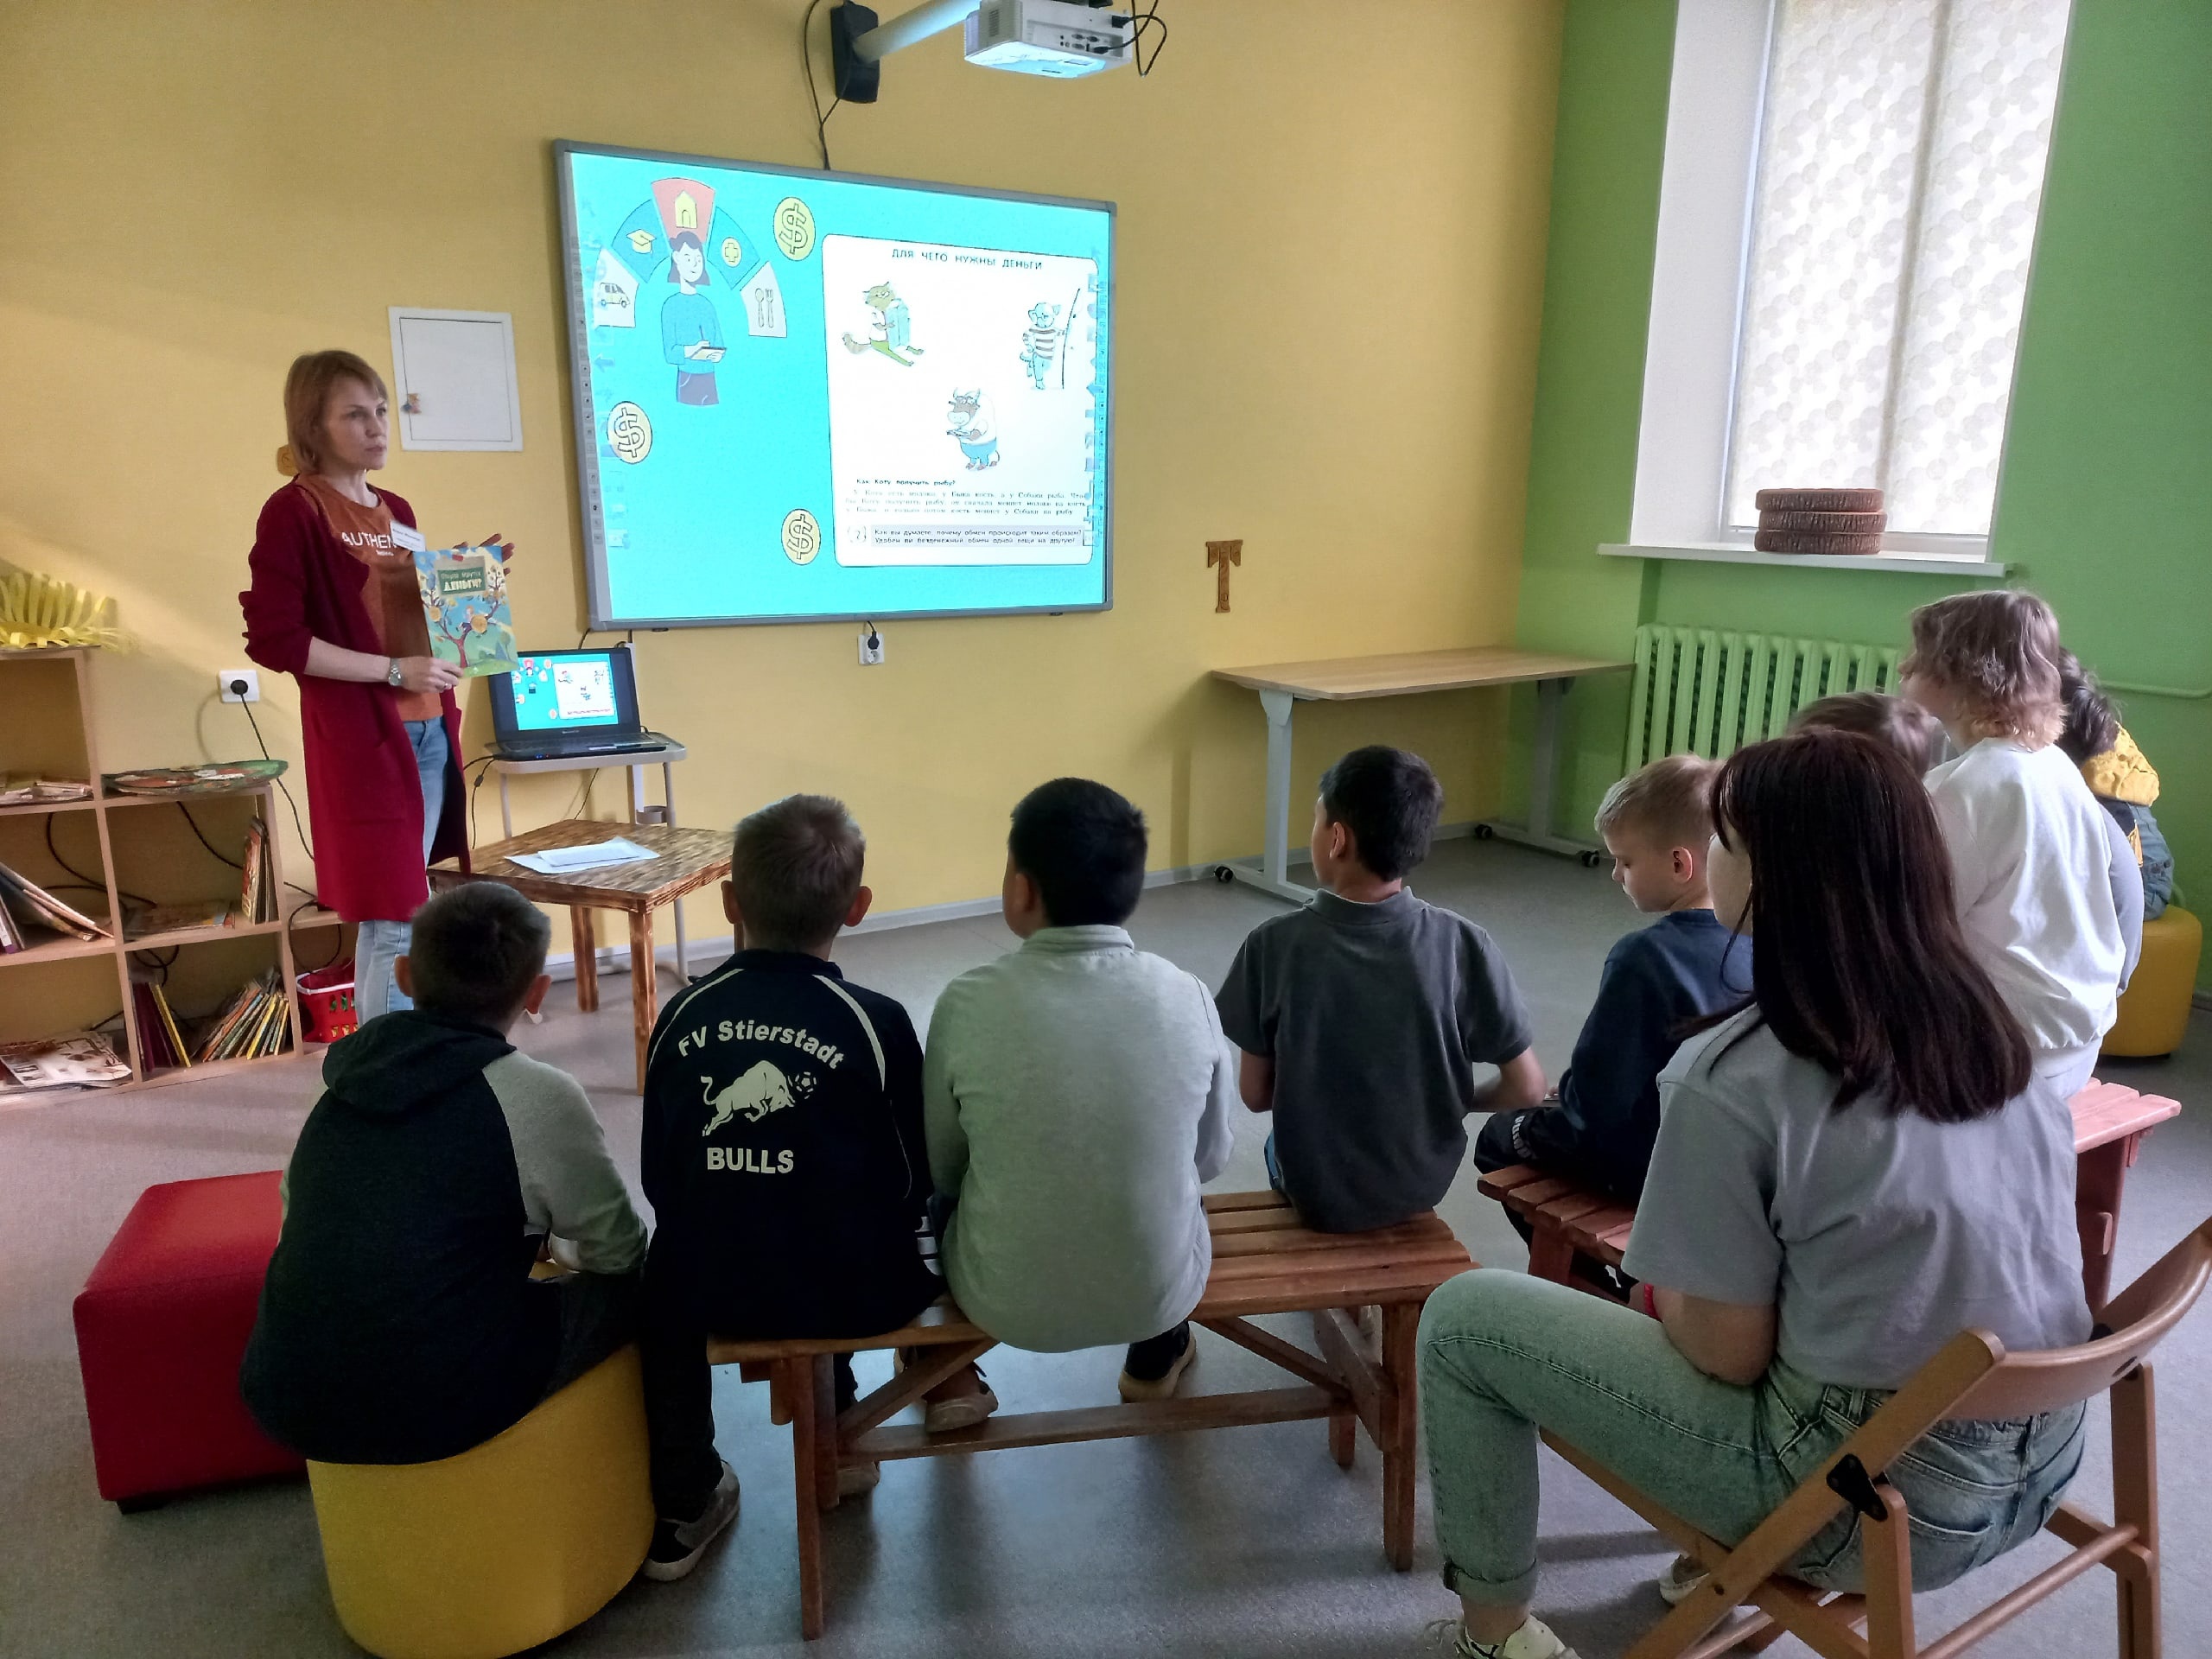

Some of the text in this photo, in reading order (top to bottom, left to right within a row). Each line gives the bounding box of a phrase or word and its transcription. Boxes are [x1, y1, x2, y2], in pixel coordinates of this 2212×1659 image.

[892, 248, 1042, 270] ДЛЯ ЧЕГО НУЖНЫ ДЕНЬГИ
[678, 1020, 844, 1070] FV Stierstadt
[707, 1147, 794, 1174] BULLS
